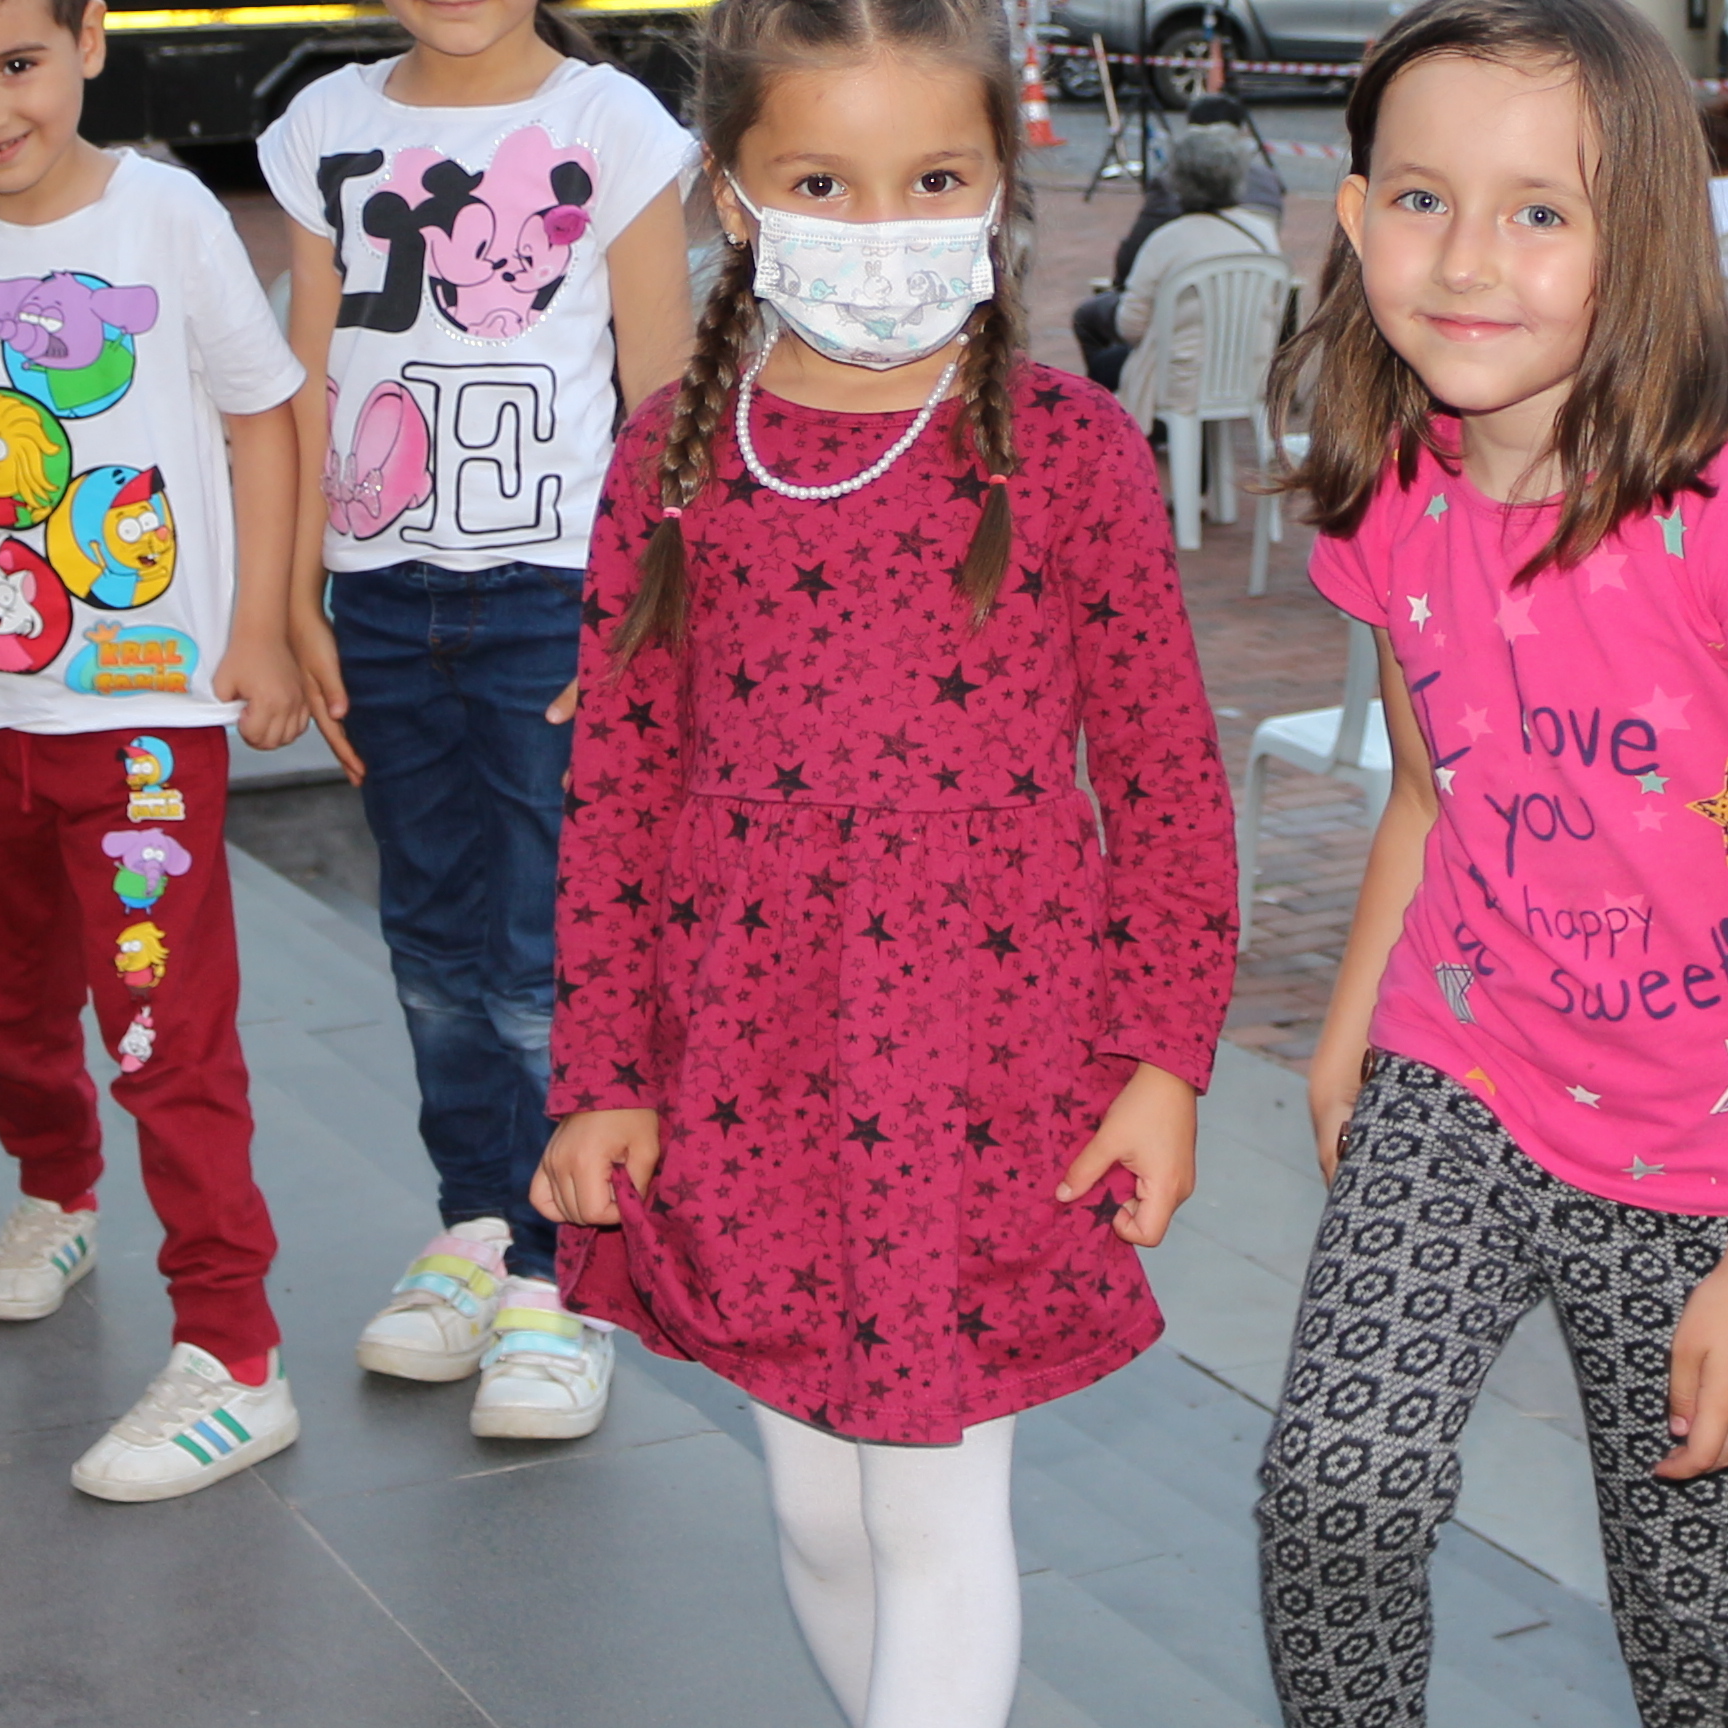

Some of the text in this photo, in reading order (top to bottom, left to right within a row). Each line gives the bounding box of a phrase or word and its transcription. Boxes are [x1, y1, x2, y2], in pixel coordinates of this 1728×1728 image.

[399, 360, 562, 552] E
[97, 638, 184, 668] KRAL
[1411, 638, 1661, 777] I love
[1483, 791, 1596, 879] you
[1523, 883, 1654, 962] happy
